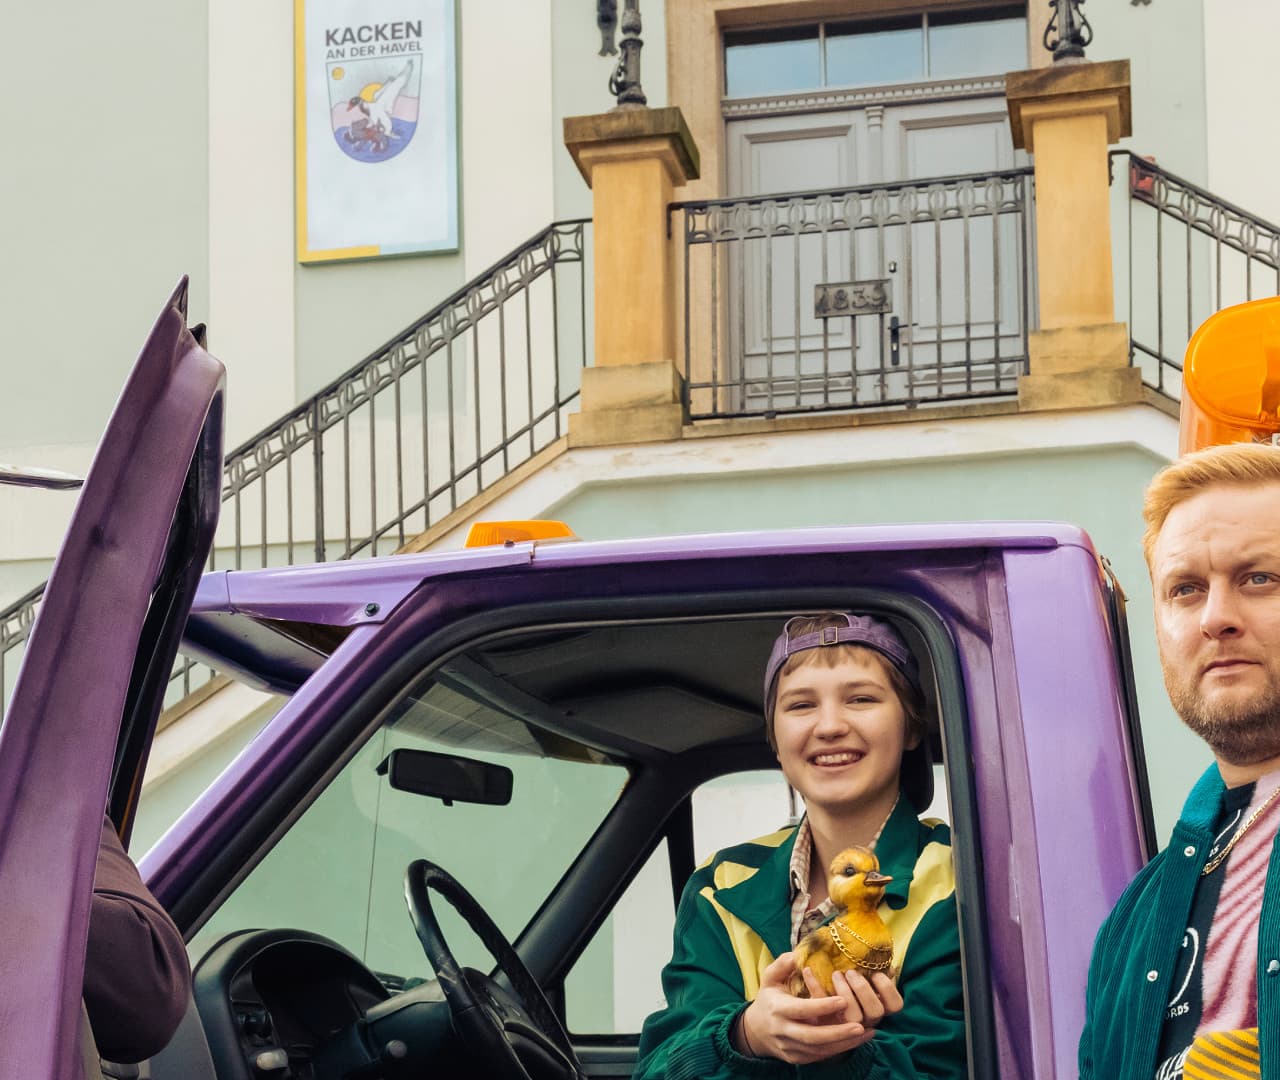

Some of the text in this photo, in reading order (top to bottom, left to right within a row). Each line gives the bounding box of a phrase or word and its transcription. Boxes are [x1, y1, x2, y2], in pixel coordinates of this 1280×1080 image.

[325, 20, 423, 47] KACKEN
[326, 41, 423, 60] AN DER HAVEL
